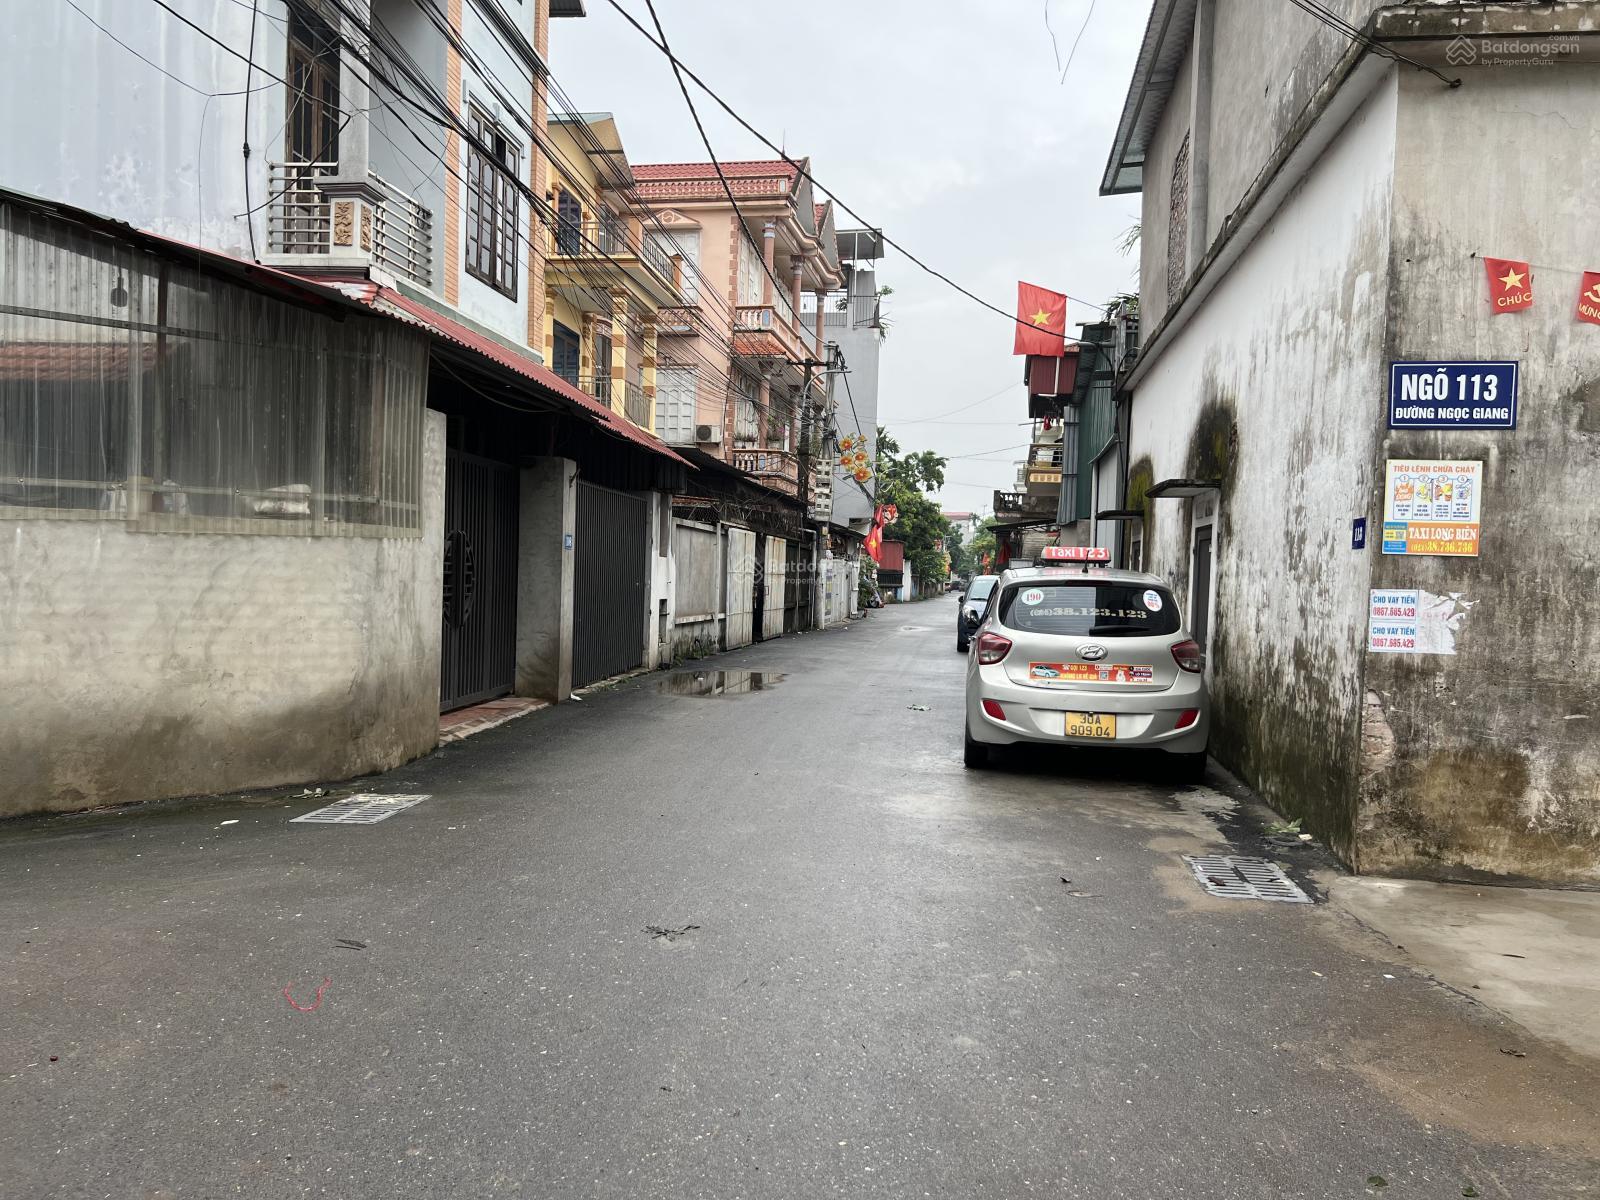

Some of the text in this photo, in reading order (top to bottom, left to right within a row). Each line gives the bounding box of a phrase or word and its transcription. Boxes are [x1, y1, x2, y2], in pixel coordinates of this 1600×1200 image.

[1497, 292, 1533, 307] CHÚC
[1401, 367, 1498, 402] NGÕ 113
[1395, 405, 1509, 421] ĐƯỜNG NGỌC GIANG
[1408, 527, 1430, 539] TAXI
[1430, 527, 1454, 540] LONG
[1051, 547, 1105, 558] Taxi 123
[1373, 595, 1386, 604] CHO
[1387, 595, 1400, 604] VAY
[1372, 626, 1386, 635] CHO
[1386, 626, 1399, 635] VAY
[1079, 713, 1102, 725] 30A
[1070, 724, 1110, 736] 909.04
